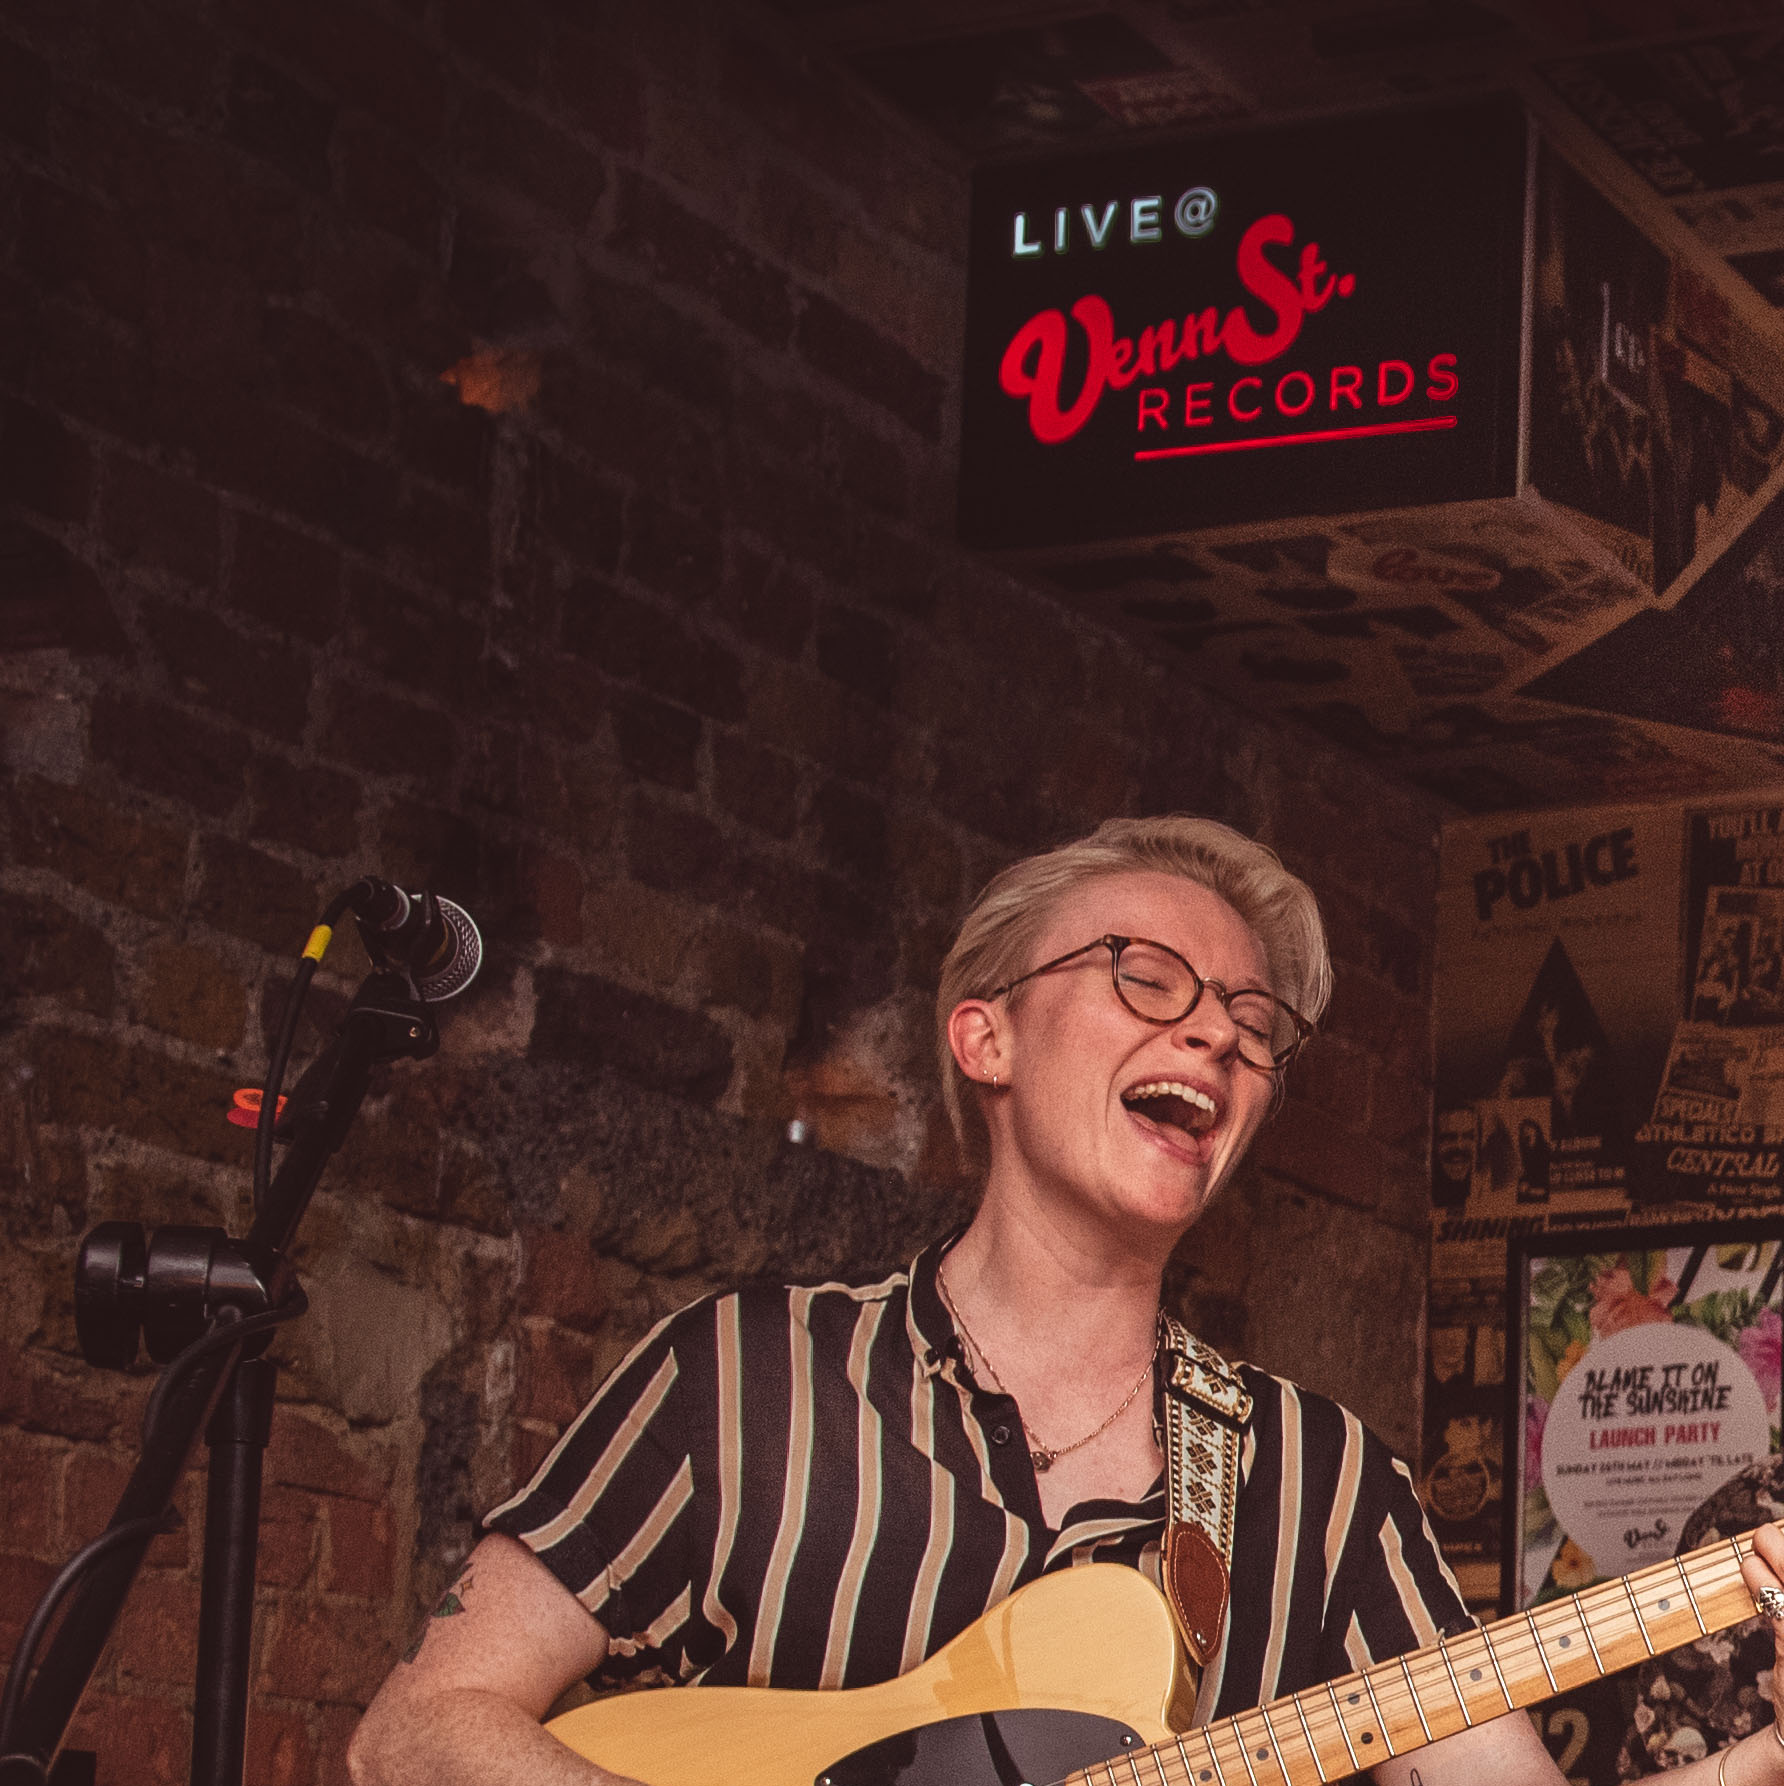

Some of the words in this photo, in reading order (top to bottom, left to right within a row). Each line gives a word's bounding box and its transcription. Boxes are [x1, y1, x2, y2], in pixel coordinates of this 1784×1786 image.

[1012, 185, 1219, 259] LIVE@
[1136, 352, 1460, 432] RECORDS
[1486, 830, 1531, 866] THE
[1472, 827, 1640, 921] POLICE
[1666, 1145, 1781, 1179] CENTRAL
[1584, 1366, 1653, 1392] BLAME
[1661, 1363, 1687, 1387] IT
[1691, 1361, 1719, 1387] ON
[1578, 1392, 1618, 1420] THE
[1626, 1385, 1731, 1416] SUNSHINE
[1589, 1426, 1656, 1450] LAUNCH
[1664, 1421, 1721, 1444] PARTY
